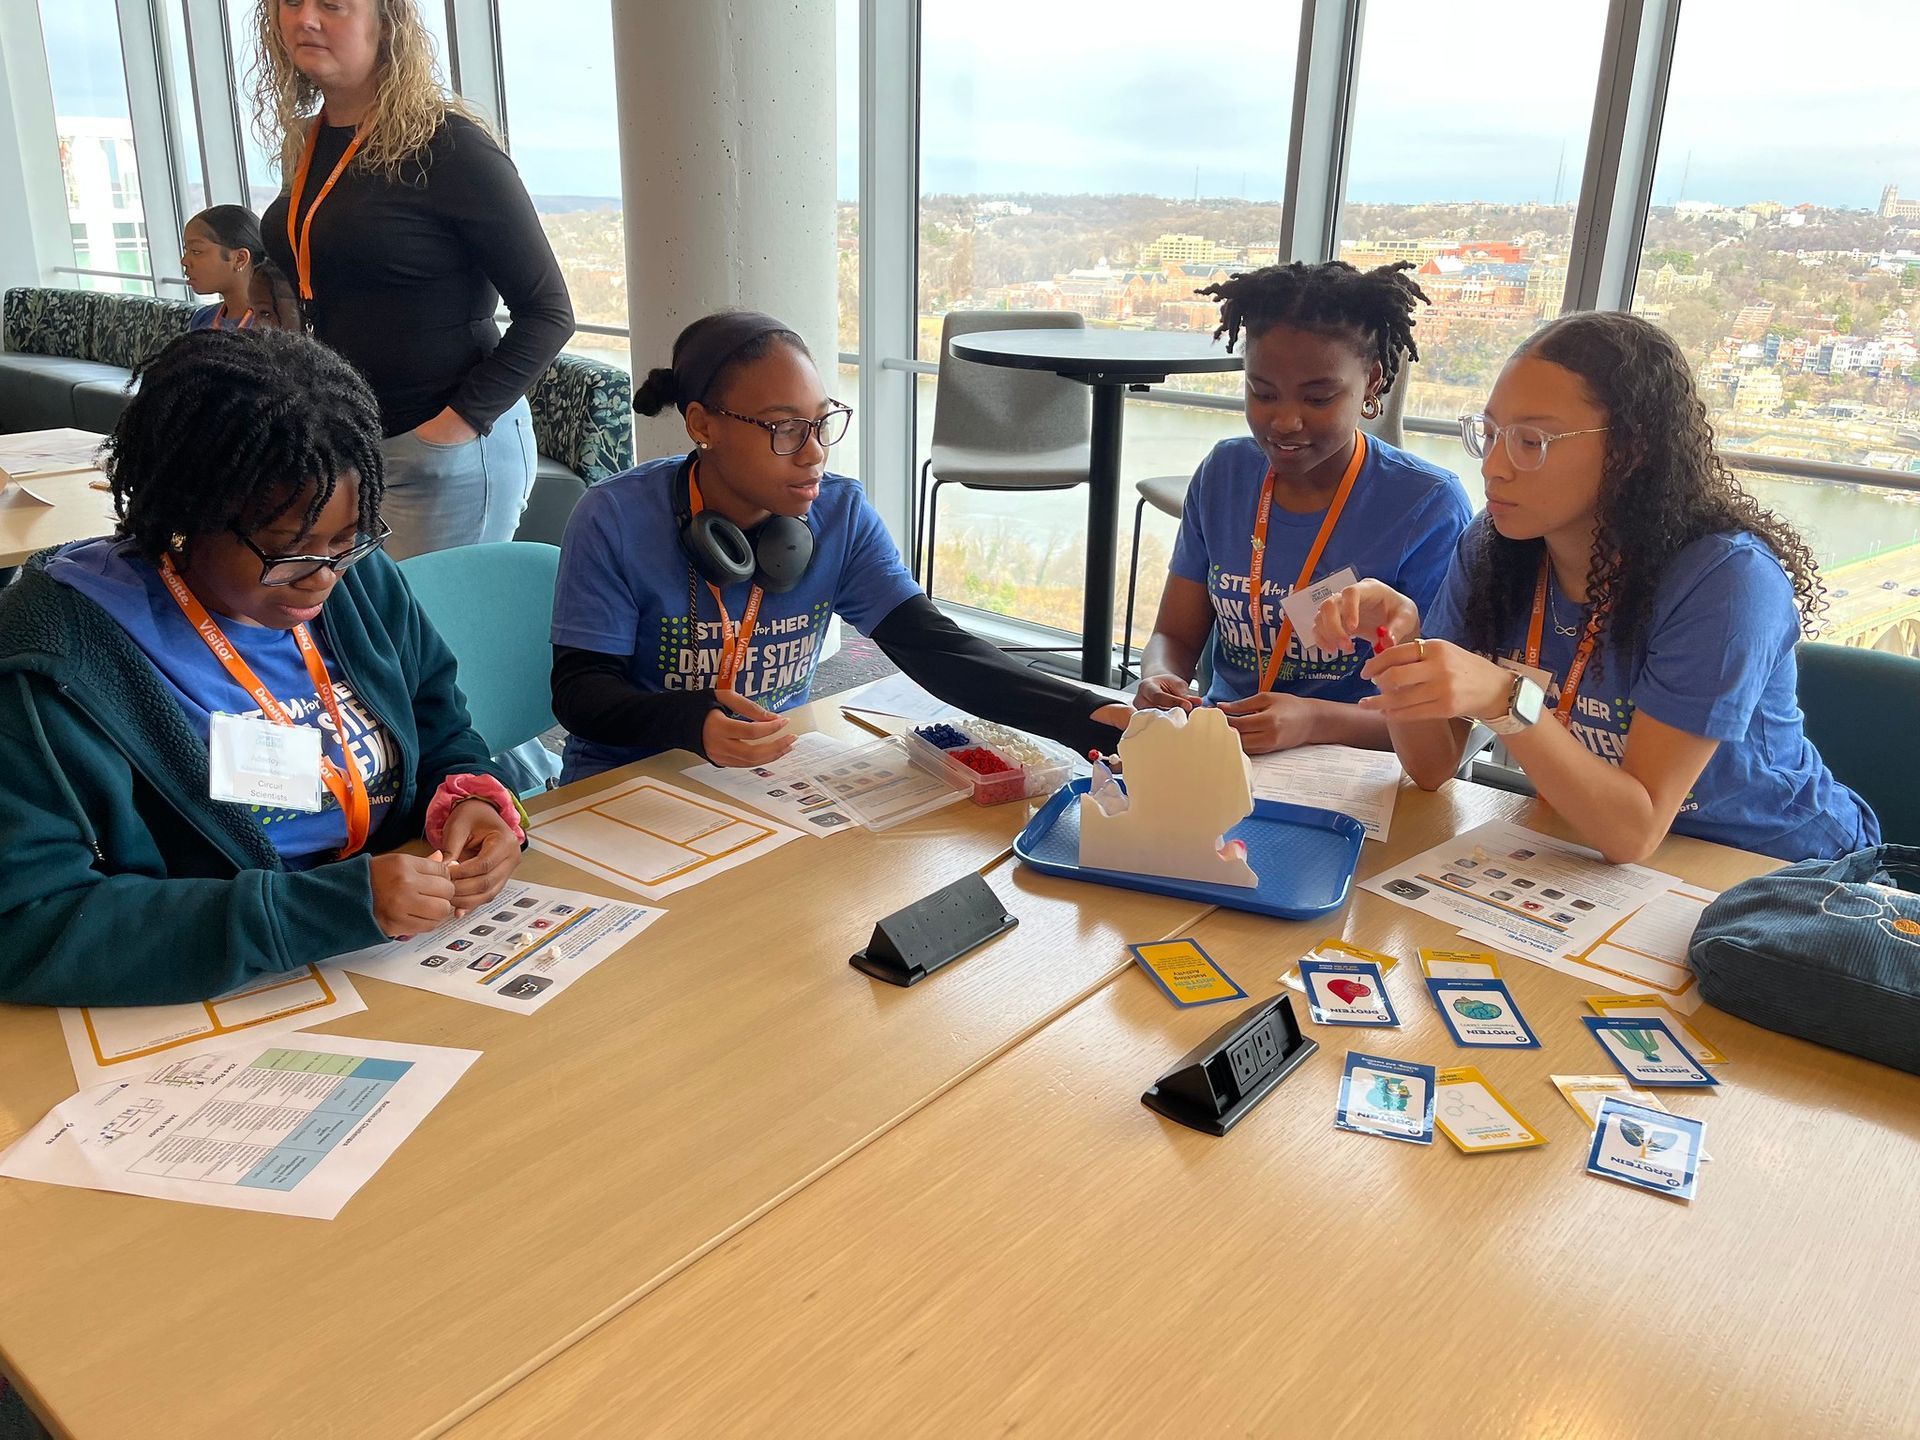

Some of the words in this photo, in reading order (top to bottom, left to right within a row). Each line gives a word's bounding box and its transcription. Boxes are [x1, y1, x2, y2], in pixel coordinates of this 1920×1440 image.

[1270, 583, 1286, 596] for
[1211, 593, 1245, 621] DAY
[753, 620, 770, 636] for
[772, 614, 809, 635] HER
[200, 619, 234, 662] Visitor
[679, 647, 723, 674] DAY
[762, 631, 816, 668] STEM
[302, 697, 320, 715] for
[1577, 695, 1611, 721] HER
[317, 698, 378, 744] STE
[250, 789, 288, 802] Scientists
[257, 780, 284, 790] Circuit
[1610, 1156, 1673, 1178] PROTEIN
